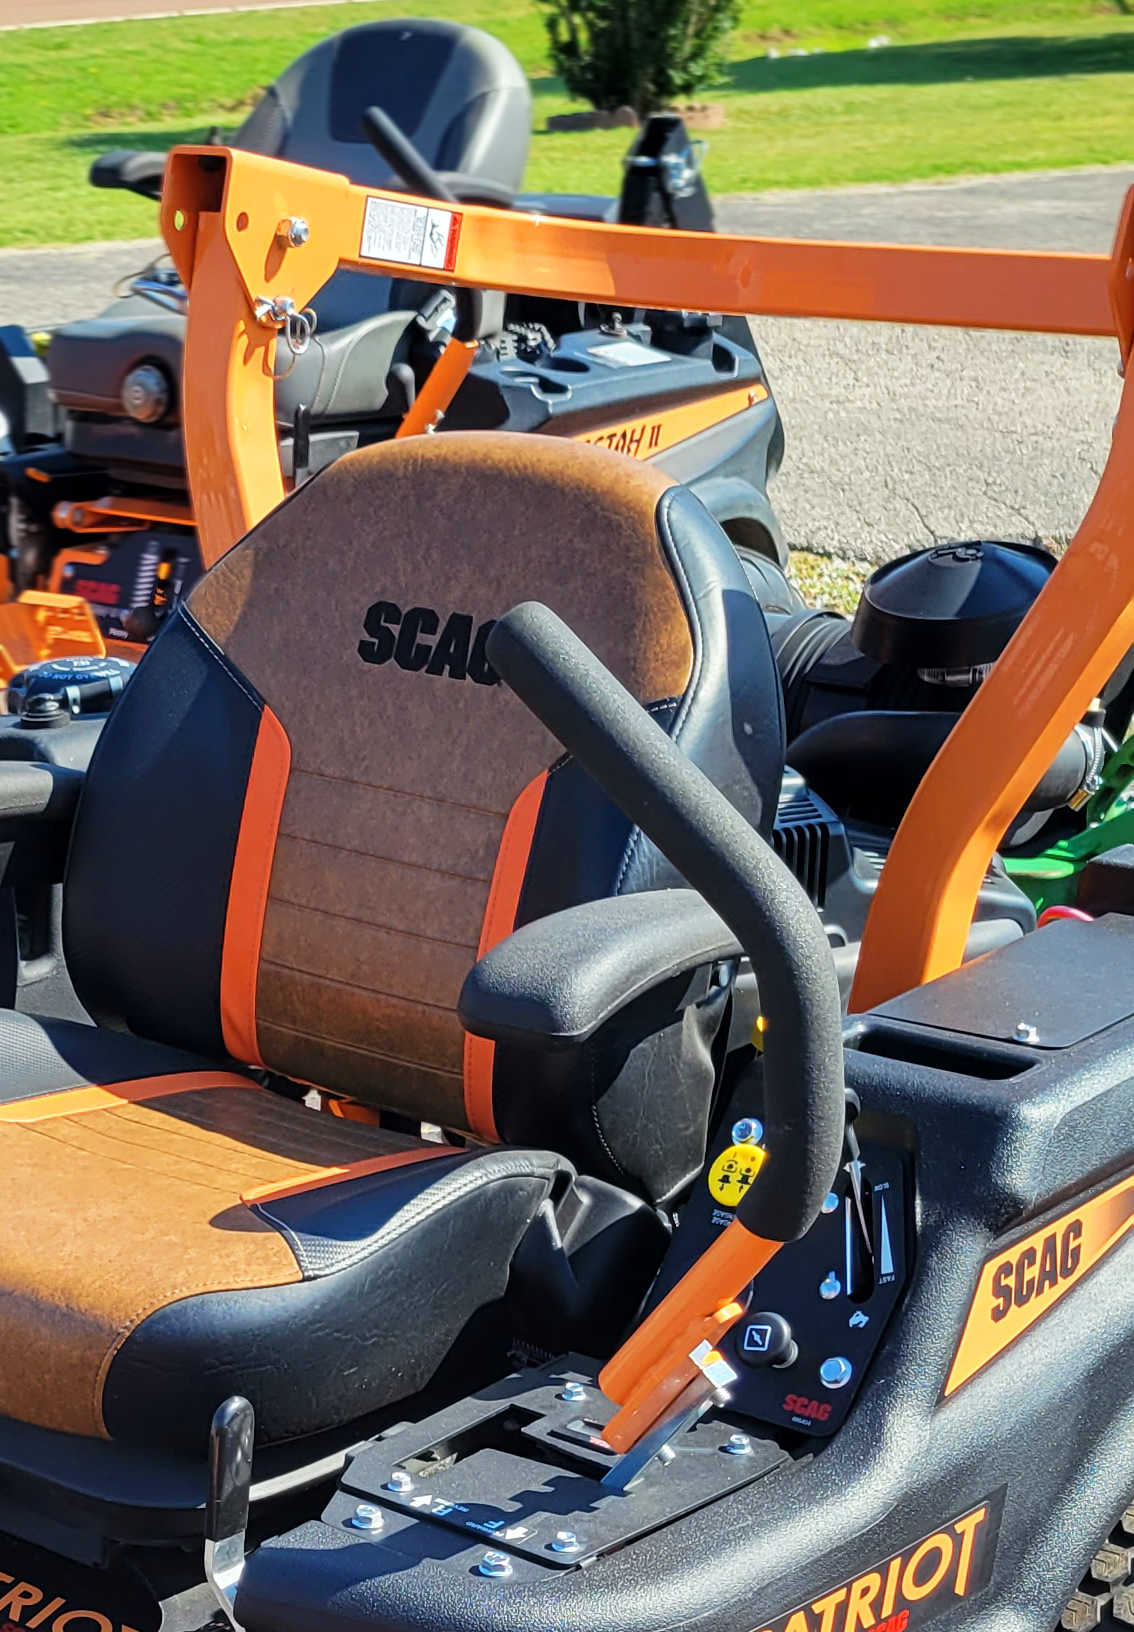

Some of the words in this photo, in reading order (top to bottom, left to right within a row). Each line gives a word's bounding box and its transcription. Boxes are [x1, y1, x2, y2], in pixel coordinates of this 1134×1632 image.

[878, 1275, 896, 1285] FAST
[990, 1218, 1084, 1324] SCAG
[782, 1394, 832, 1421] SCAG
[483, 1520, 505, 1529] F
